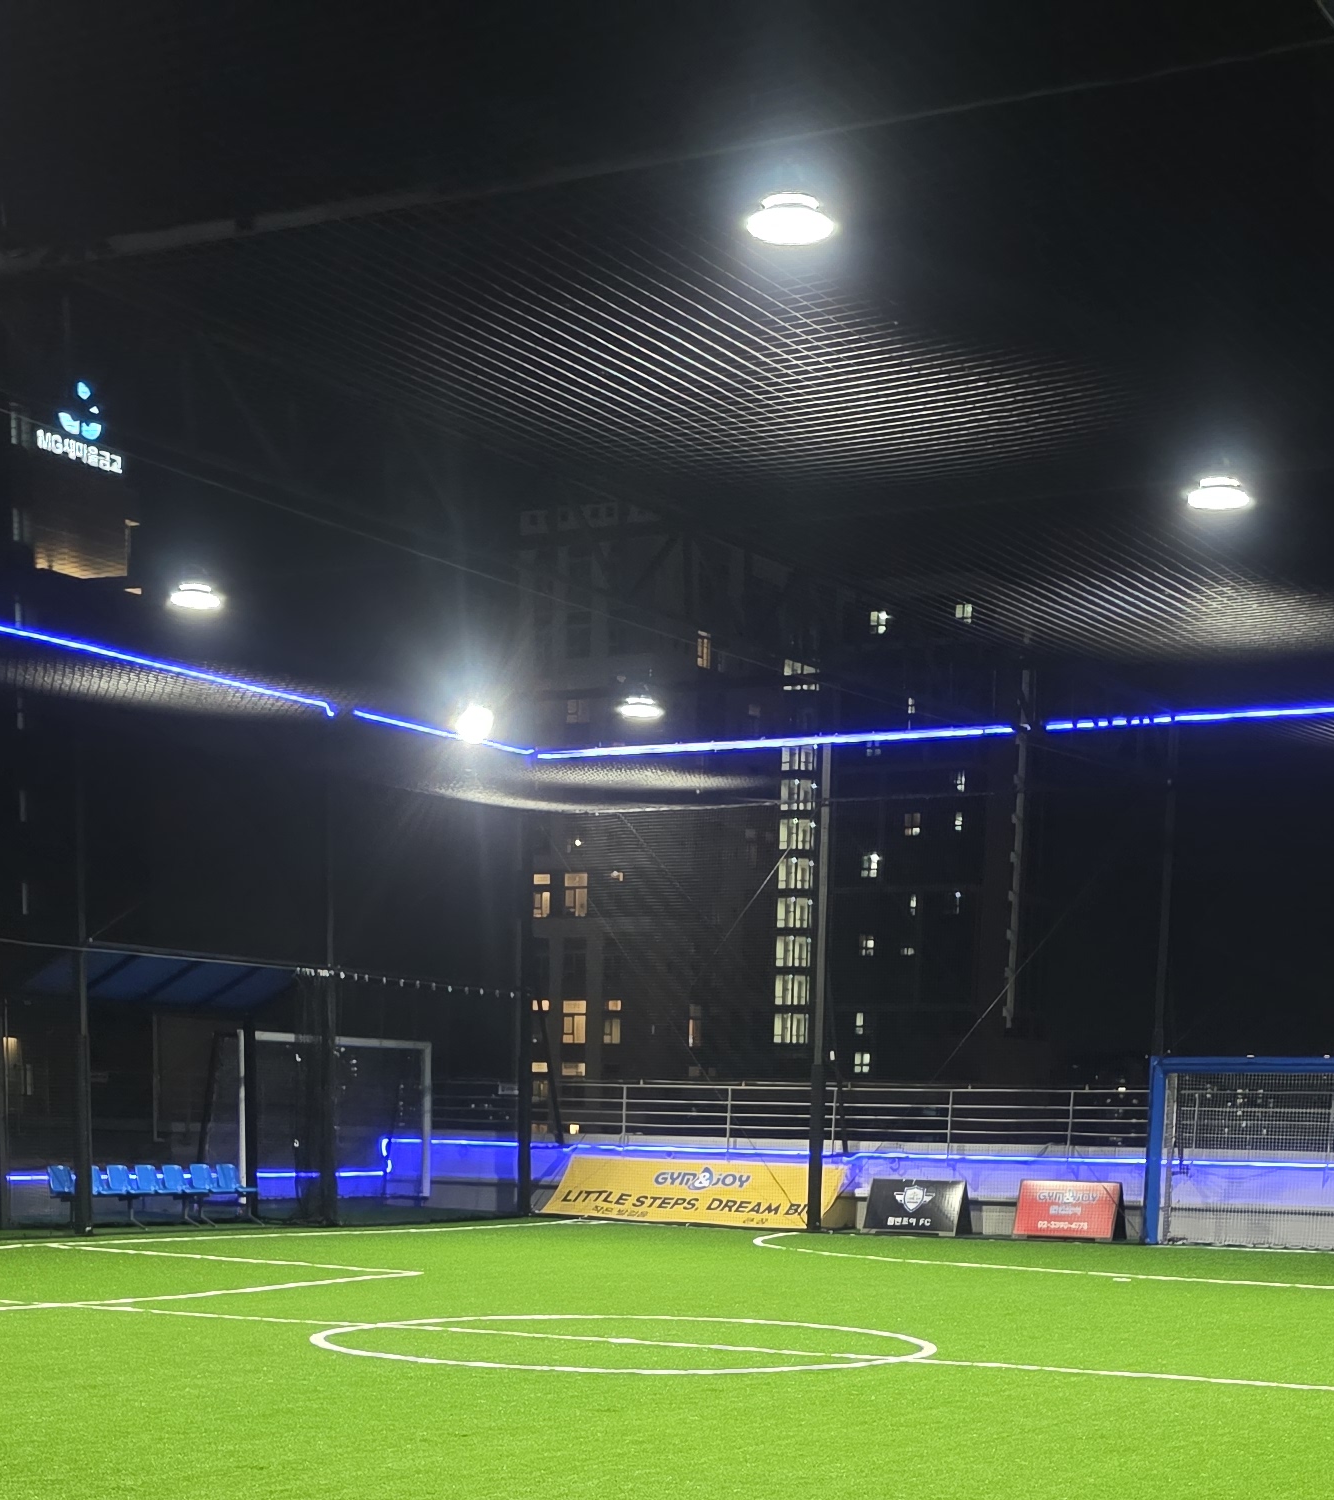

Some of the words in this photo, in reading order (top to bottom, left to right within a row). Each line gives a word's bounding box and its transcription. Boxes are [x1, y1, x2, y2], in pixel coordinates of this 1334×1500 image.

[36, 429, 123, 474] MG새마을금고
[561, 1189, 632, 1206] LITTLE
[632, 1195, 699, 1212] STEPS,
[706, 1197, 781, 1215] DREAM
[784, 1203, 809, 1217] BI
[919, 1218, 931, 1226] FC
